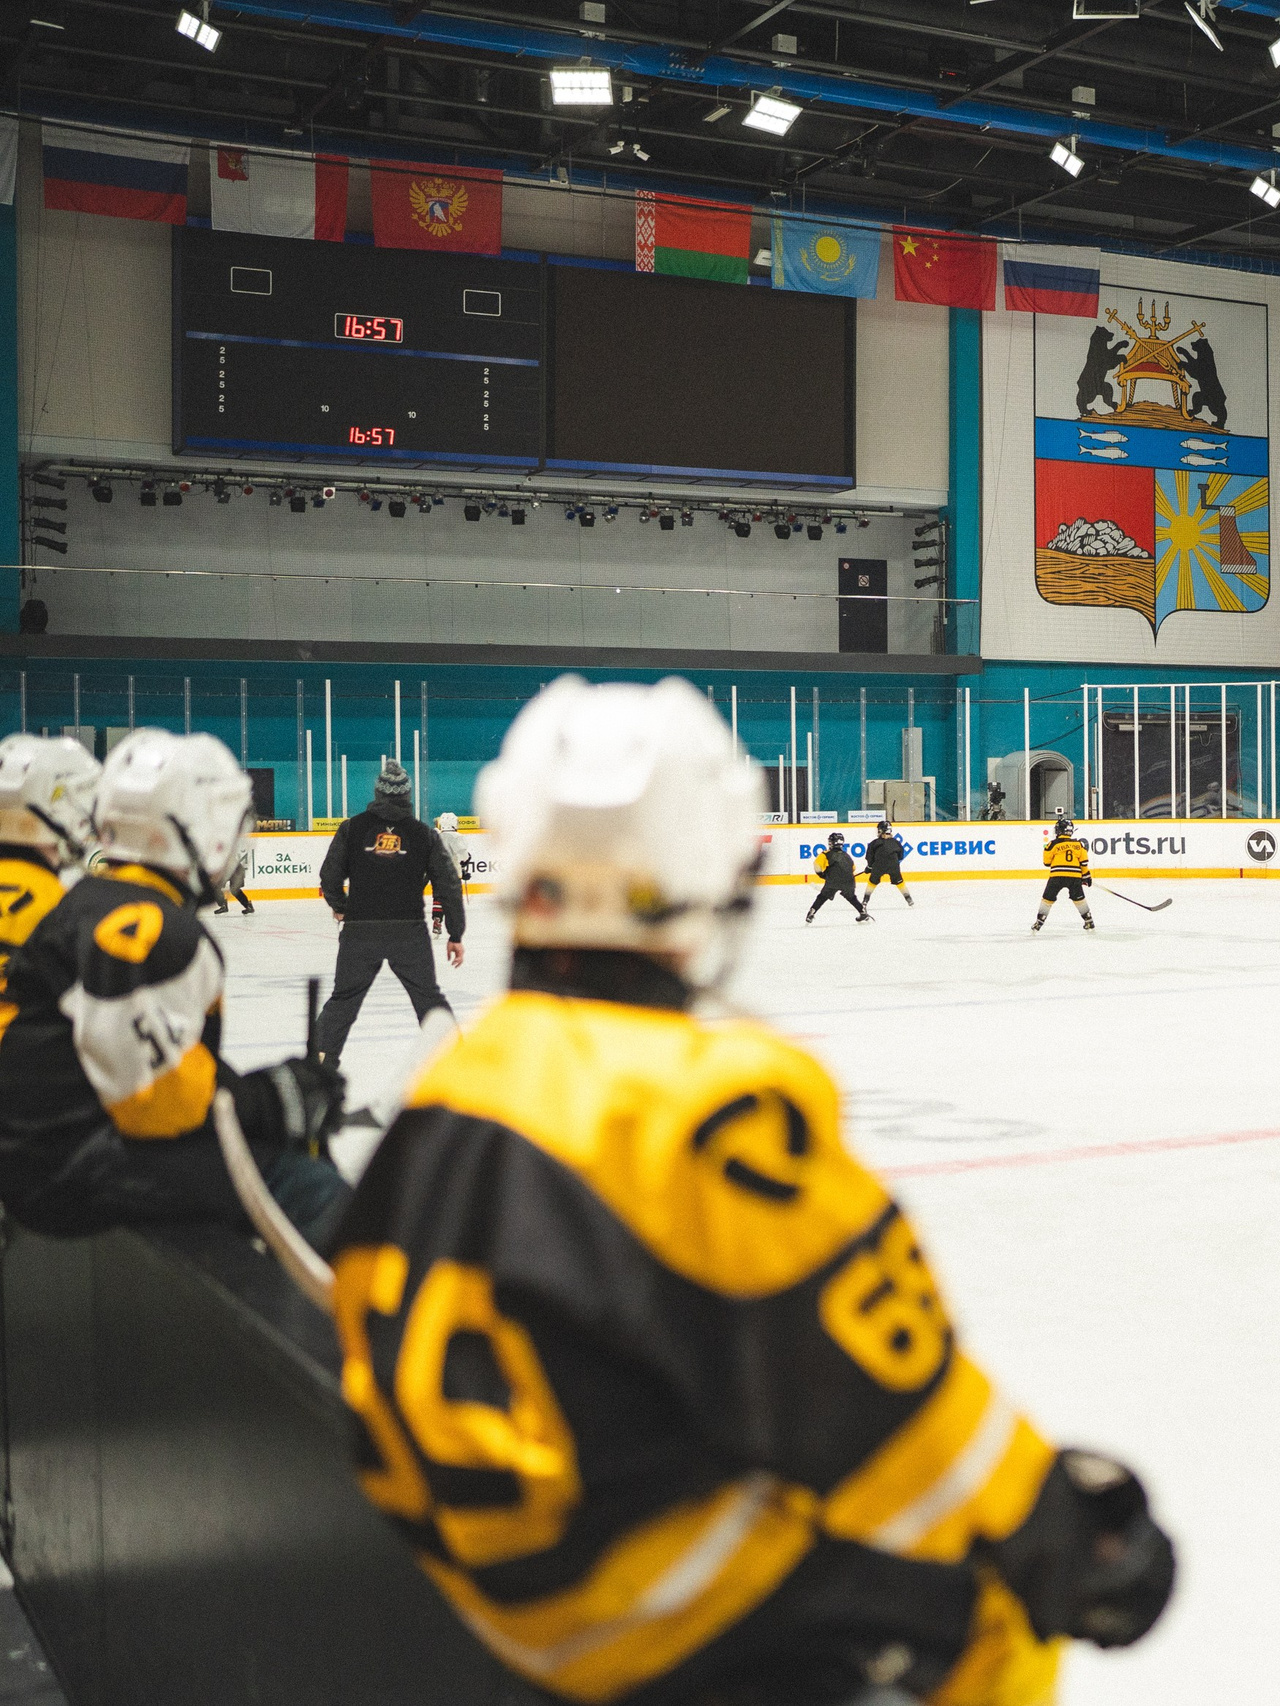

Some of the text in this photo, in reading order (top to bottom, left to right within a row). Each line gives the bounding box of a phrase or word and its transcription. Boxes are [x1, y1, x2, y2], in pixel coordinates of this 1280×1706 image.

[344, 316, 402, 341] 16:57
[219, 346, 226, 354] 2
[219, 356, 226, 364] 5
[219, 370, 225, 378] 2
[484, 367, 490, 375] 2
[218, 394, 225, 402] 2
[218, 405, 225, 413] 5
[408, 411, 416, 419] 10
[483, 423, 489, 431] 5
[349, 427, 395, 445] 16:57
[917, 840, 996, 856] СЕРВИС
[1078, 832, 1186, 856] orts.ru
[276, 853, 292, 862] ЗА
[1065, 849, 1073, 862] 6
